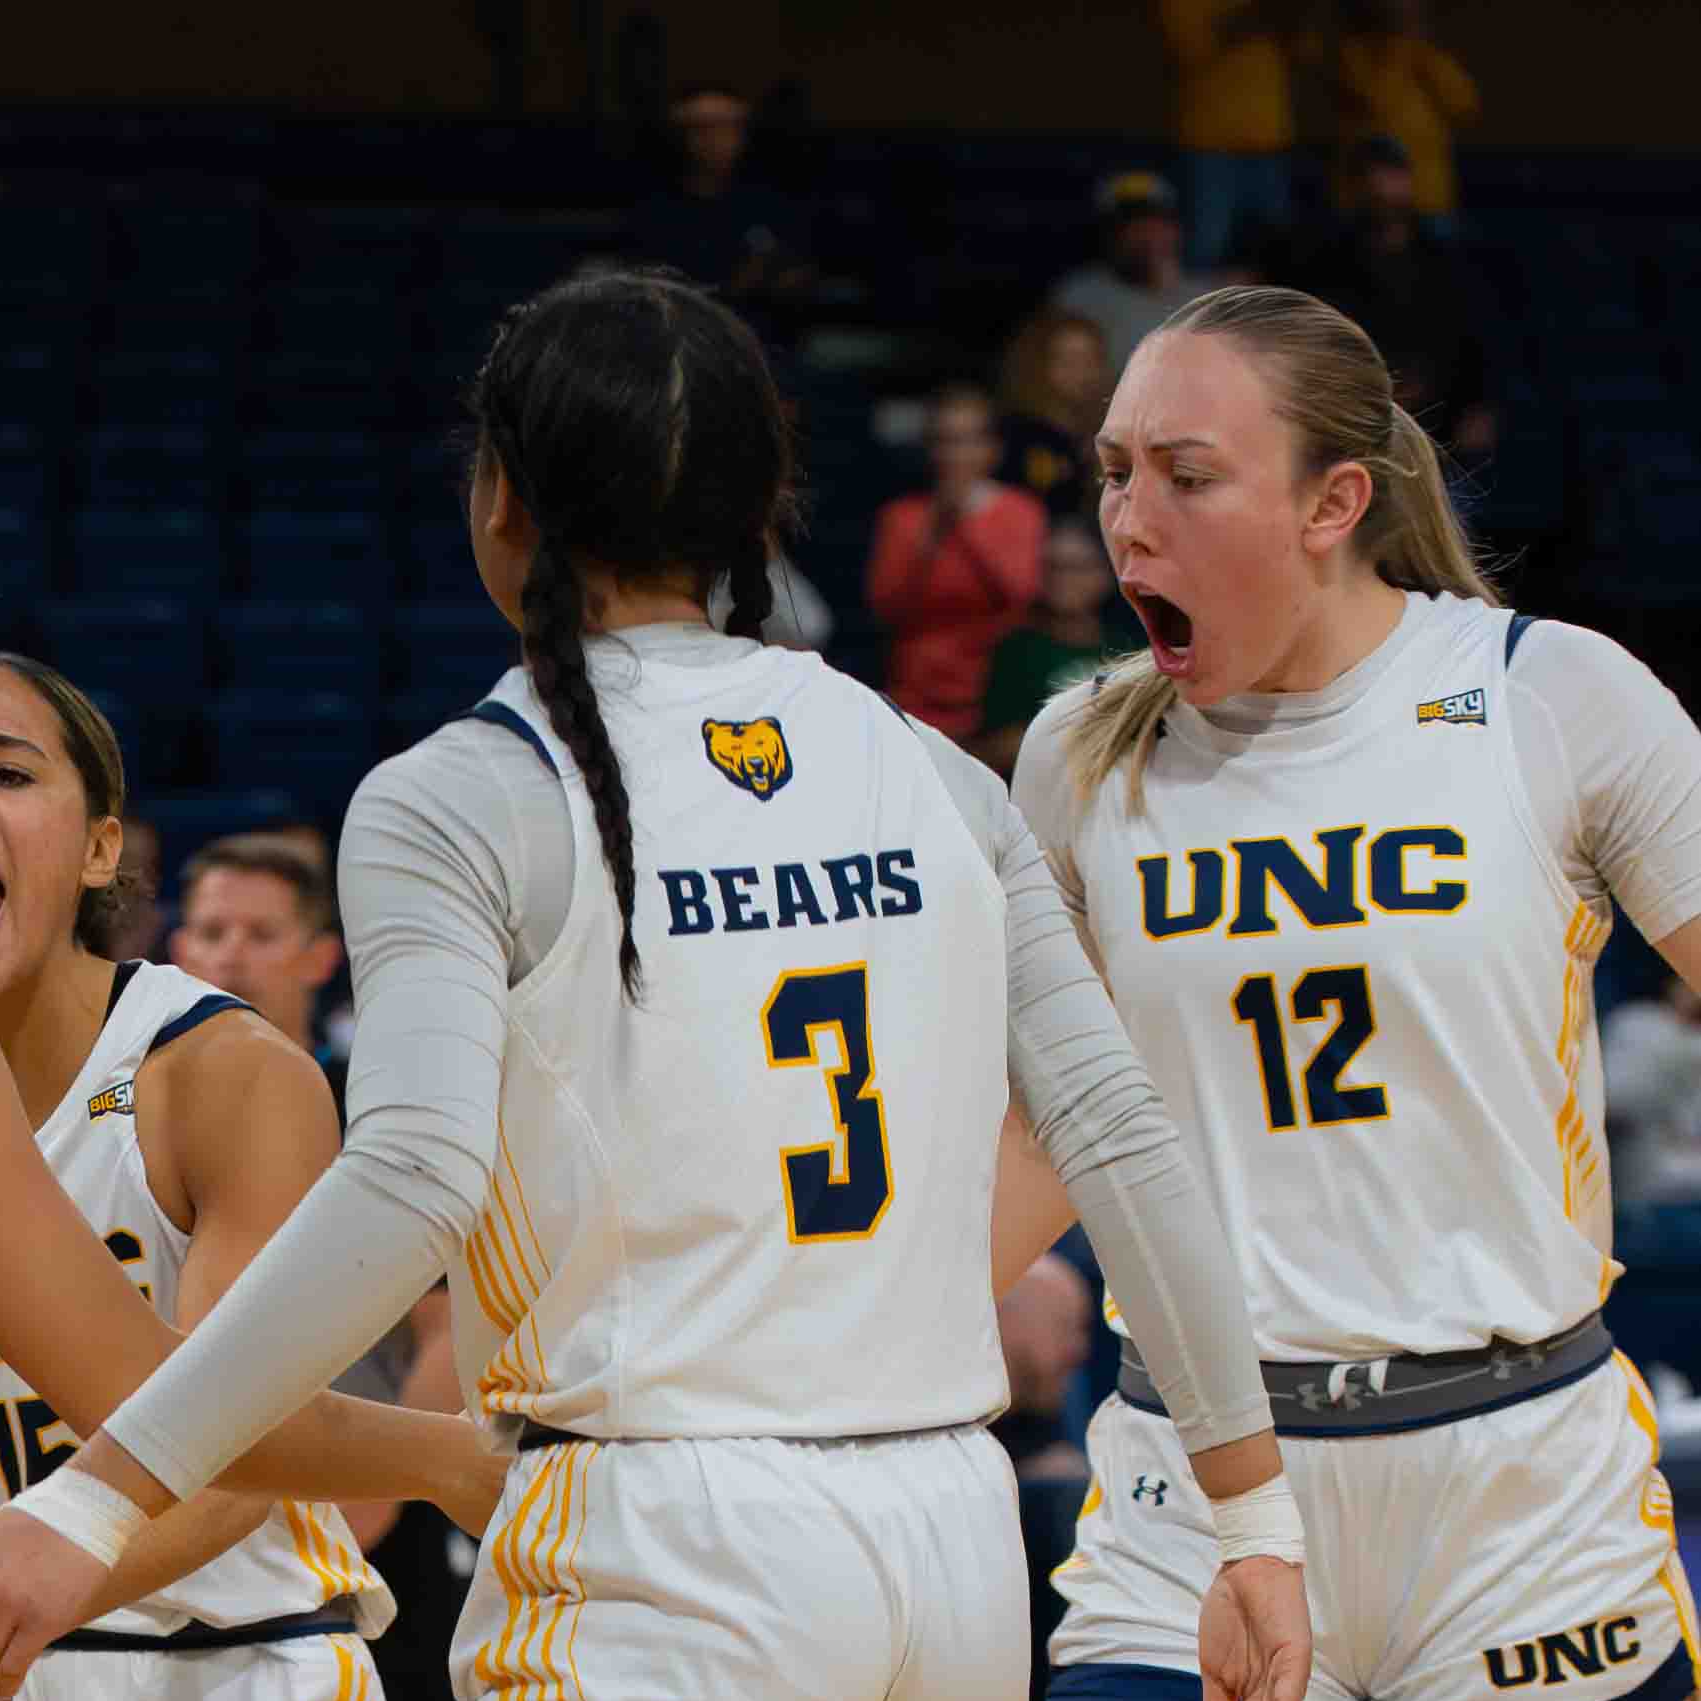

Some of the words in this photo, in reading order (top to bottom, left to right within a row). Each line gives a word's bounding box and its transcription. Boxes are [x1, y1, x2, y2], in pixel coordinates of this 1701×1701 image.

[656, 848, 924, 936] BEARS
[1135, 823, 1467, 942] UNC
[759, 959, 895, 1245] 3
[1230, 963, 1392, 1133] 12
[1482, 1615, 1641, 1688] UNC
